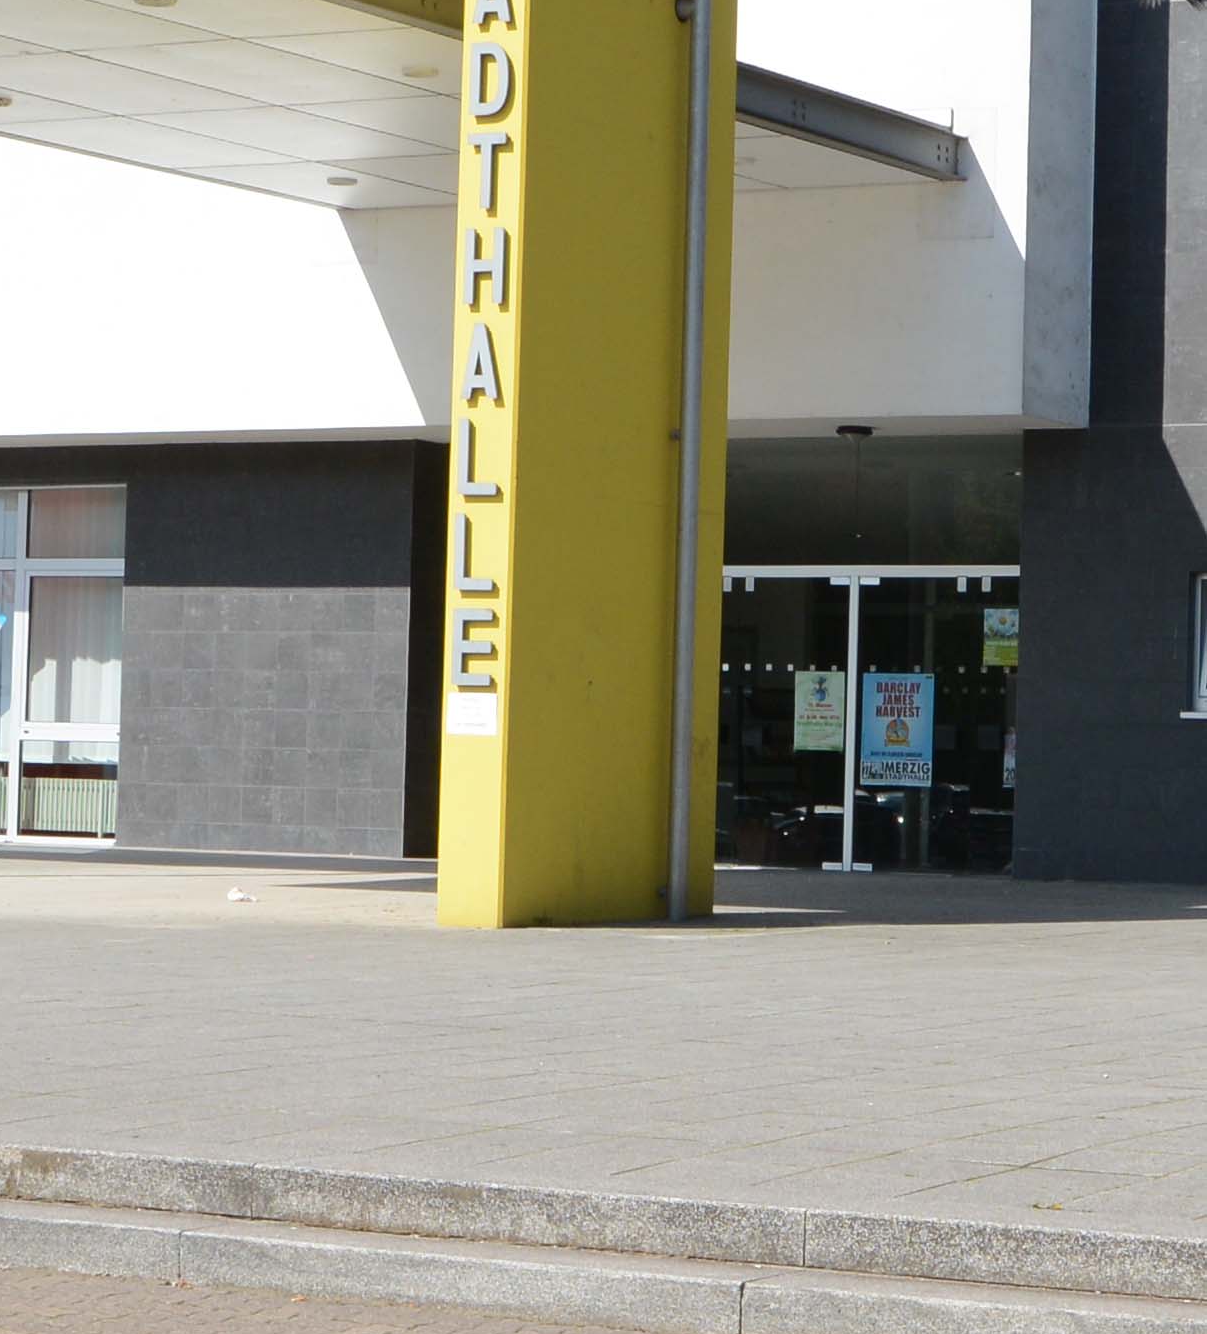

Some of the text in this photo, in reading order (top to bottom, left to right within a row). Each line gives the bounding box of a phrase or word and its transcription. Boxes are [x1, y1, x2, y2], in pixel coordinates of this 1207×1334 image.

[875, 682, 921, 694] BARCLAY
[882, 694, 914, 705] JAMES
[875, 706, 921, 718] HARVEST
[884, 762, 930, 774] MERZIG
[885, 773, 930, 781] STADTHALLE
